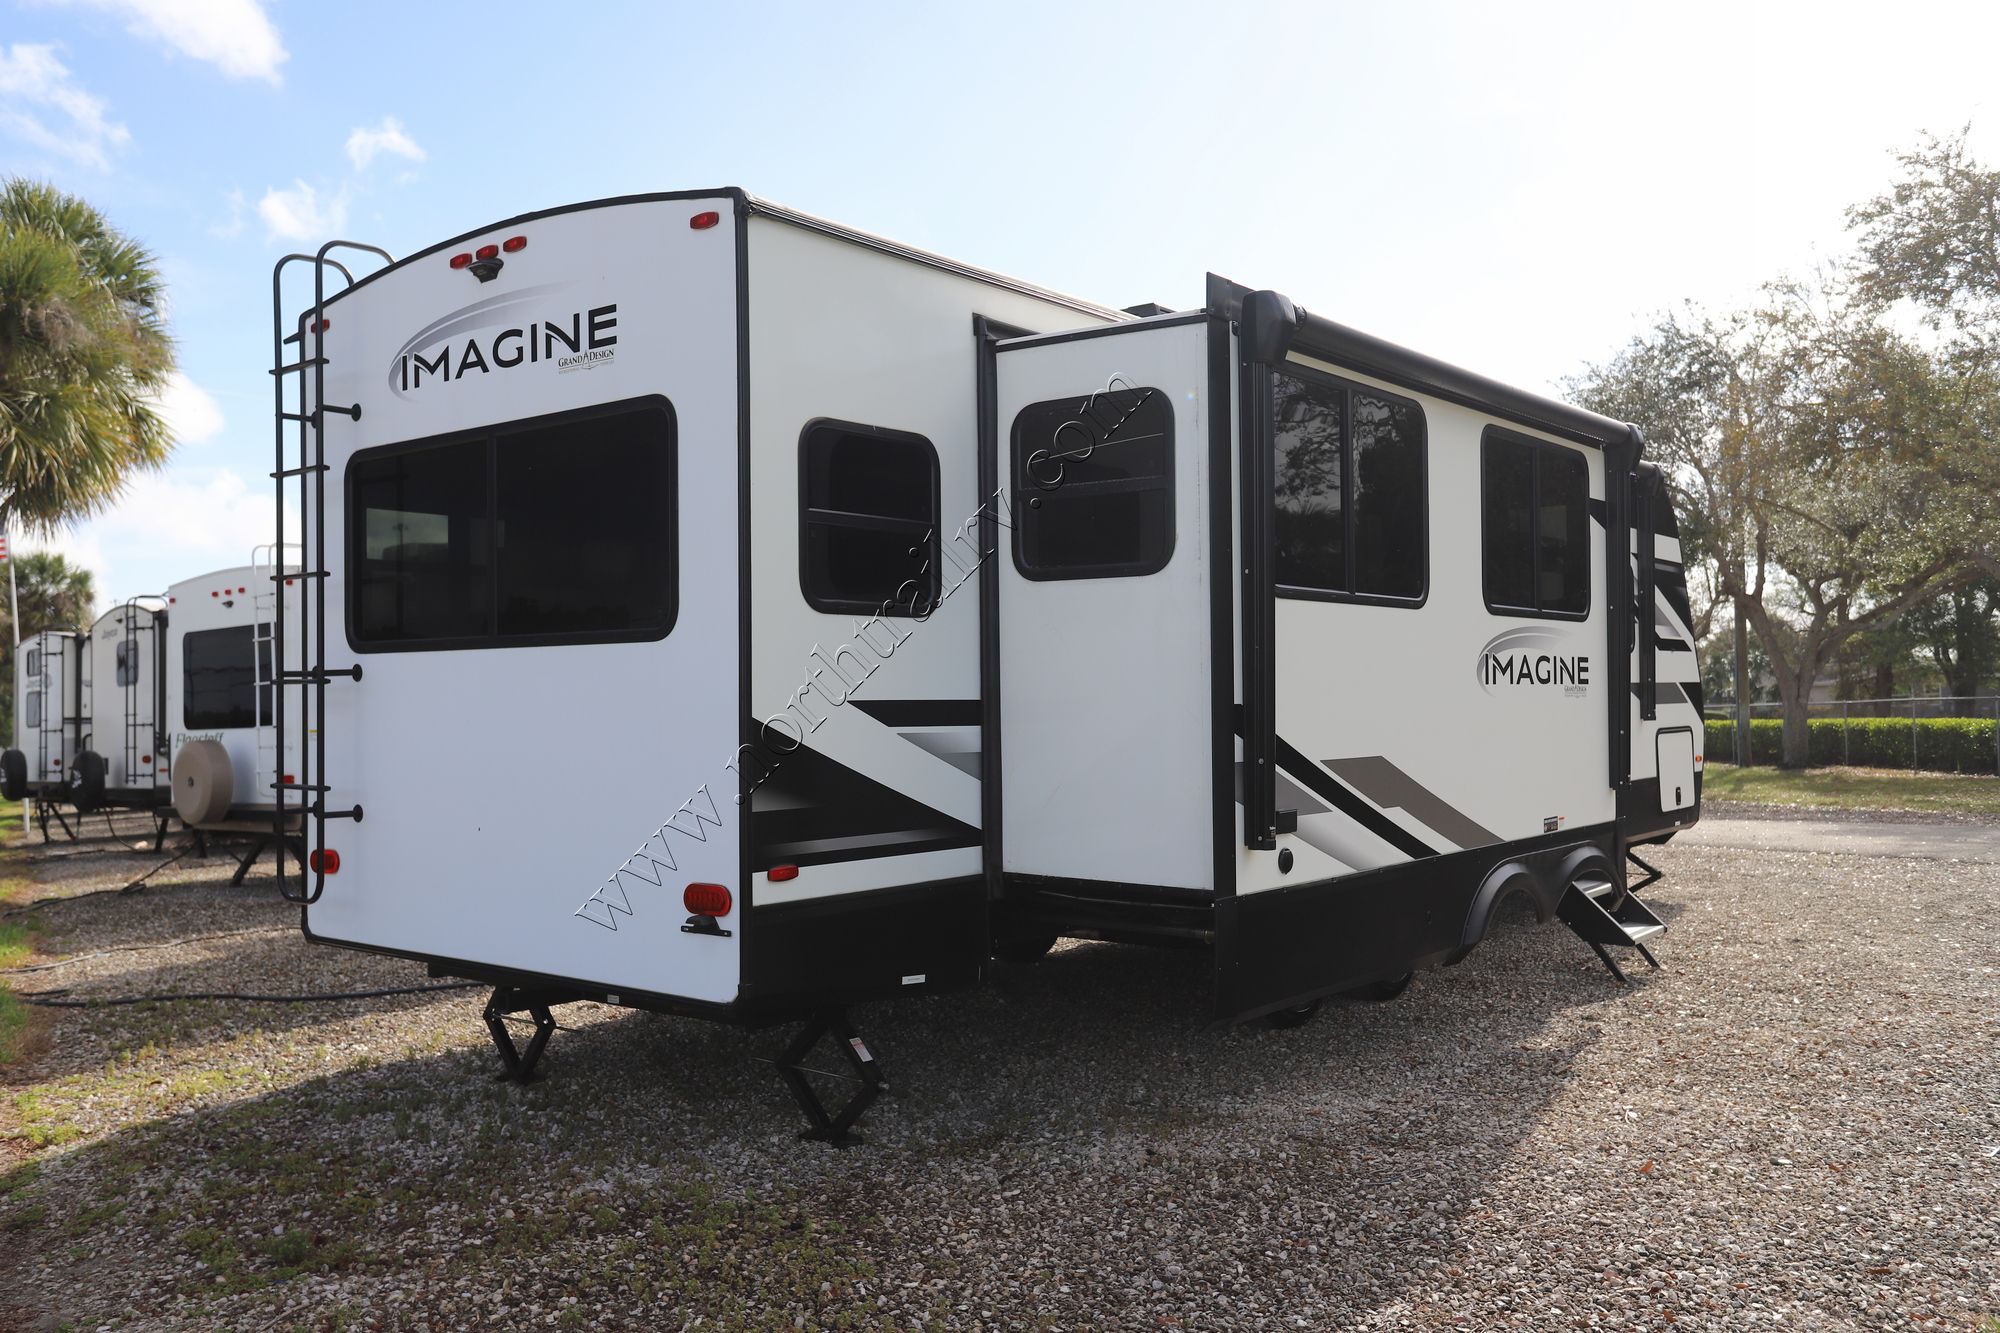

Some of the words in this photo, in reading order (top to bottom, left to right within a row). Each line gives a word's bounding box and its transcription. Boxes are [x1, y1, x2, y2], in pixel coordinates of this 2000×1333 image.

[402, 303, 617, 391] IMAGINE
[558, 355, 583, 367] GRAND
[589, 349, 615, 361] DESIGN
[1485, 653, 1589, 685] IMAGINE
